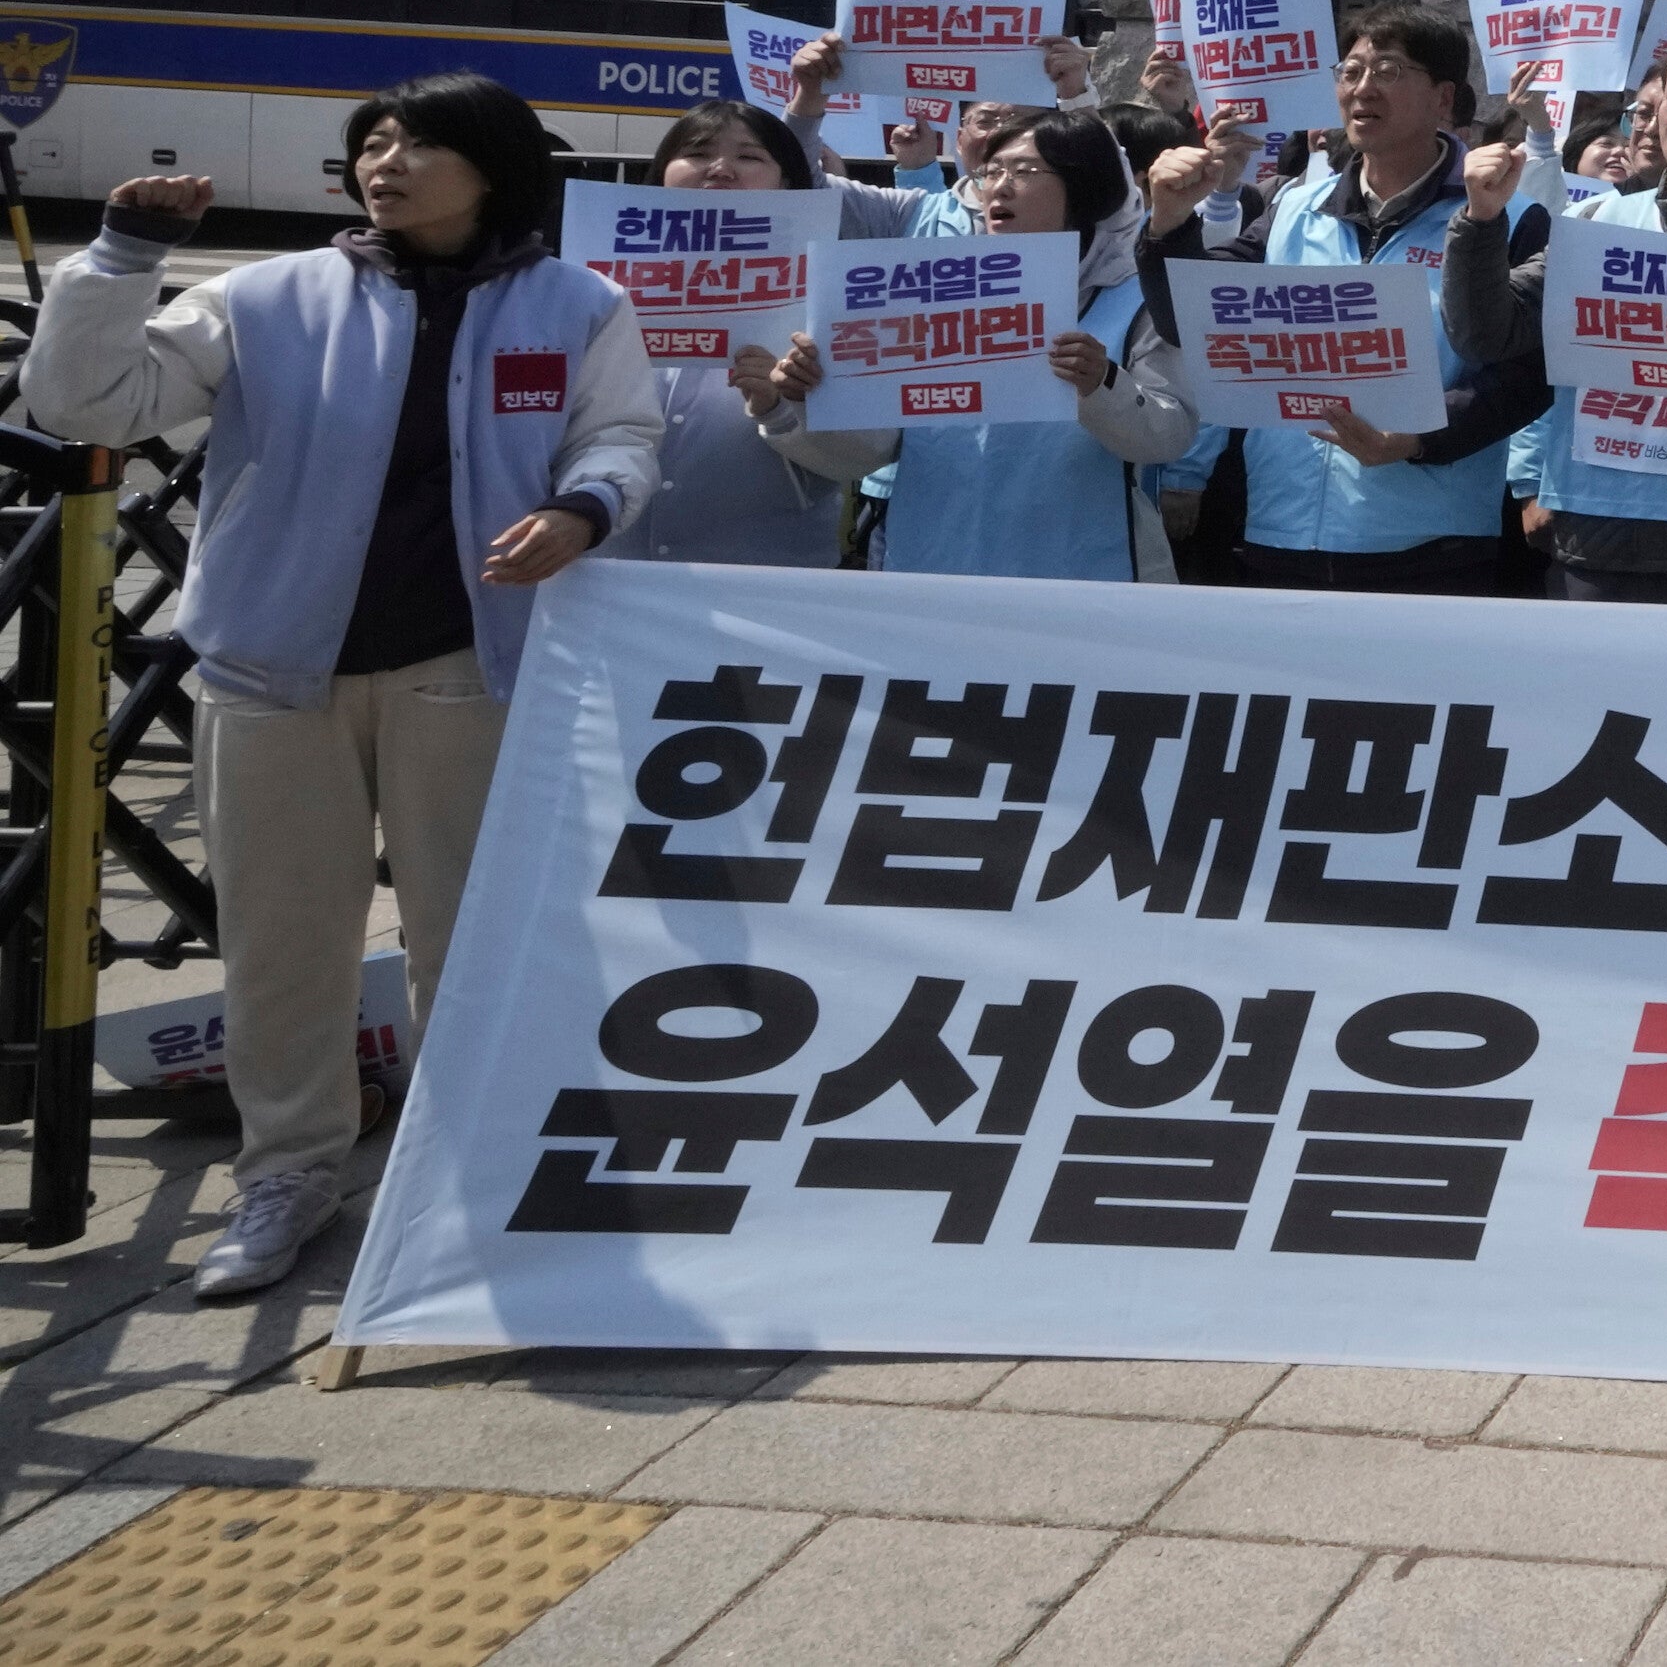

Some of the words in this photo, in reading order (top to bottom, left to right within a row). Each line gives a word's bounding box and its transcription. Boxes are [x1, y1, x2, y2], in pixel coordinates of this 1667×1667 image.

[852, 5, 1042, 46] 파면선고!
[1486, 3, 1622, 49] 파면선고!
[599, 61, 721, 97] POLICE
[911, 65, 970, 88] 진보당
[614, 206, 773, 254] 헌재는
[844, 252, 1023, 311] 윤석열은
[1210, 281, 1379, 325] 윤석열은
[645, 332, 721, 354] 진보당
[830, 302, 1046, 367] 즉각파면!
[1205, 327, 1408, 375] 즉각파면!
[500, 390, 561, 408] 진보당
[907, 384, 975, 411] 진보당
[1594, 435, 1644, 459] 진보당
[506, 962, 1540, 1262] 윤석열을
